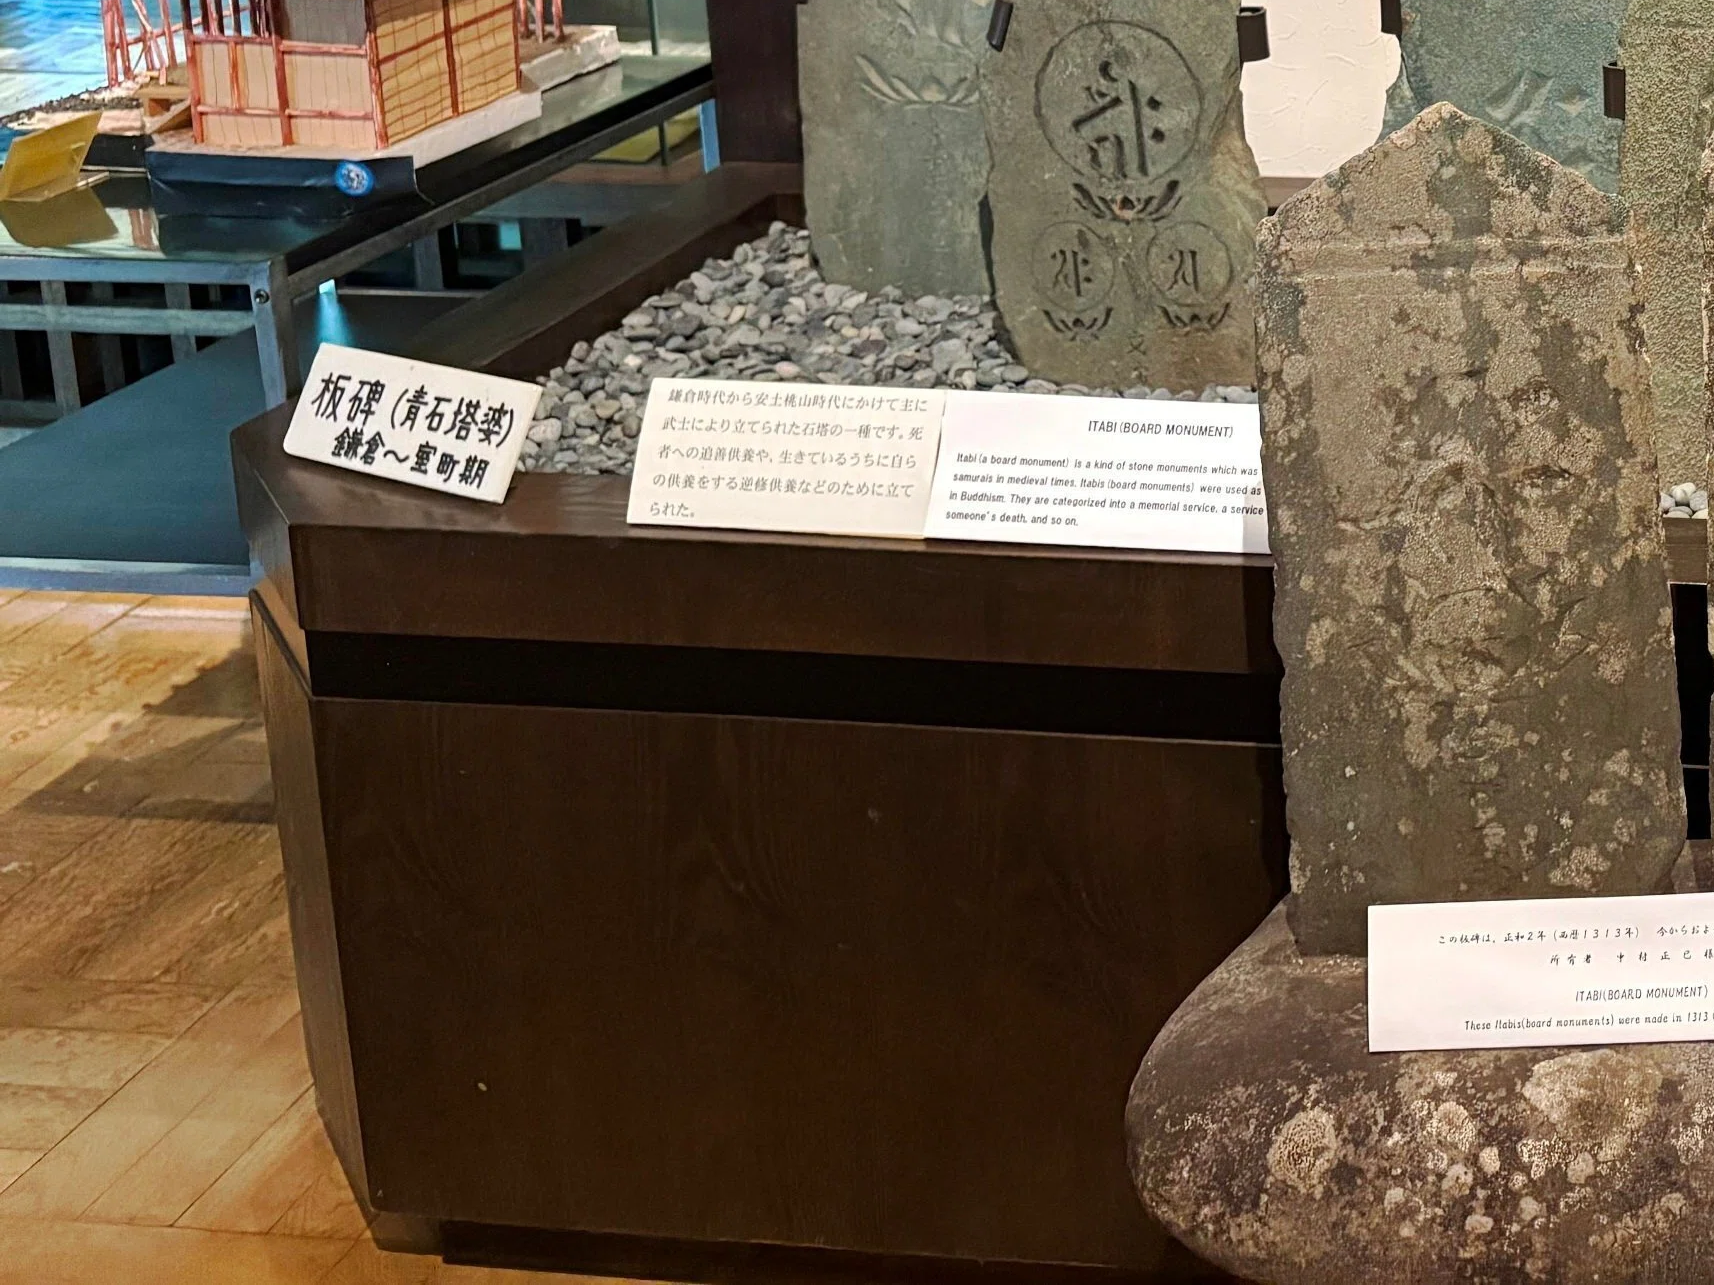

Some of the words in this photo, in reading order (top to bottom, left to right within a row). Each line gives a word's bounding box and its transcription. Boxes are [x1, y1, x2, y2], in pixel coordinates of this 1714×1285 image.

[1165, 424, 1234, 438] MONUMENT)
[990, 454, 1018, 466] board
[1019, 457, 1070, 468] monument)
[1074, 459, 1082, 469] is
[1085, 461, 1091, 469] a
[1093, 459, 1114, 470] kind
[1115, 460, 1126, 471] of
[1128, 461, 1154, 472] stone
[1156, 464, 1208, 474] monuments
[1211, 465, 1237, 475] which
[1240, 468, 1259, 476] was
[952, 473, 993, 484] samurais
[995, 474, 1005, 484] in
[1006, 475, 1049, 486] medieval
[1050, 476, 1077, 488] times.
[1080, 477, 1105, 489] Itabis
[1139, 482, 1195, 493] monuments)
[1199, 485, 1222, 494] were
[1225, 485, 1249, 496] used
[1250, 487, 1262, 496] as
[649, 501, 695, 518] られた。
[948, 491, 958, 500] in
[960, 491, 1005, 503] Buddhism.
[1010, 494, 1032, 505] They
[1034, 496, 1050, 505] are
[1052, 496, 1107, 509] categorized
[1108, 498, 1127, 509] into
[1129, 501, 1136, 510] a
[1137, 501, 1180, 512] memorial
[1182, 503, 1218, 514] service,
[1221, 505, 1228, 514] a
[1230, 504, 1265, 516] service
[1030, 514, 1049, 525] and
[1050, 517, 1063, 526] so
[1064, 517, 1079, 527] on.
